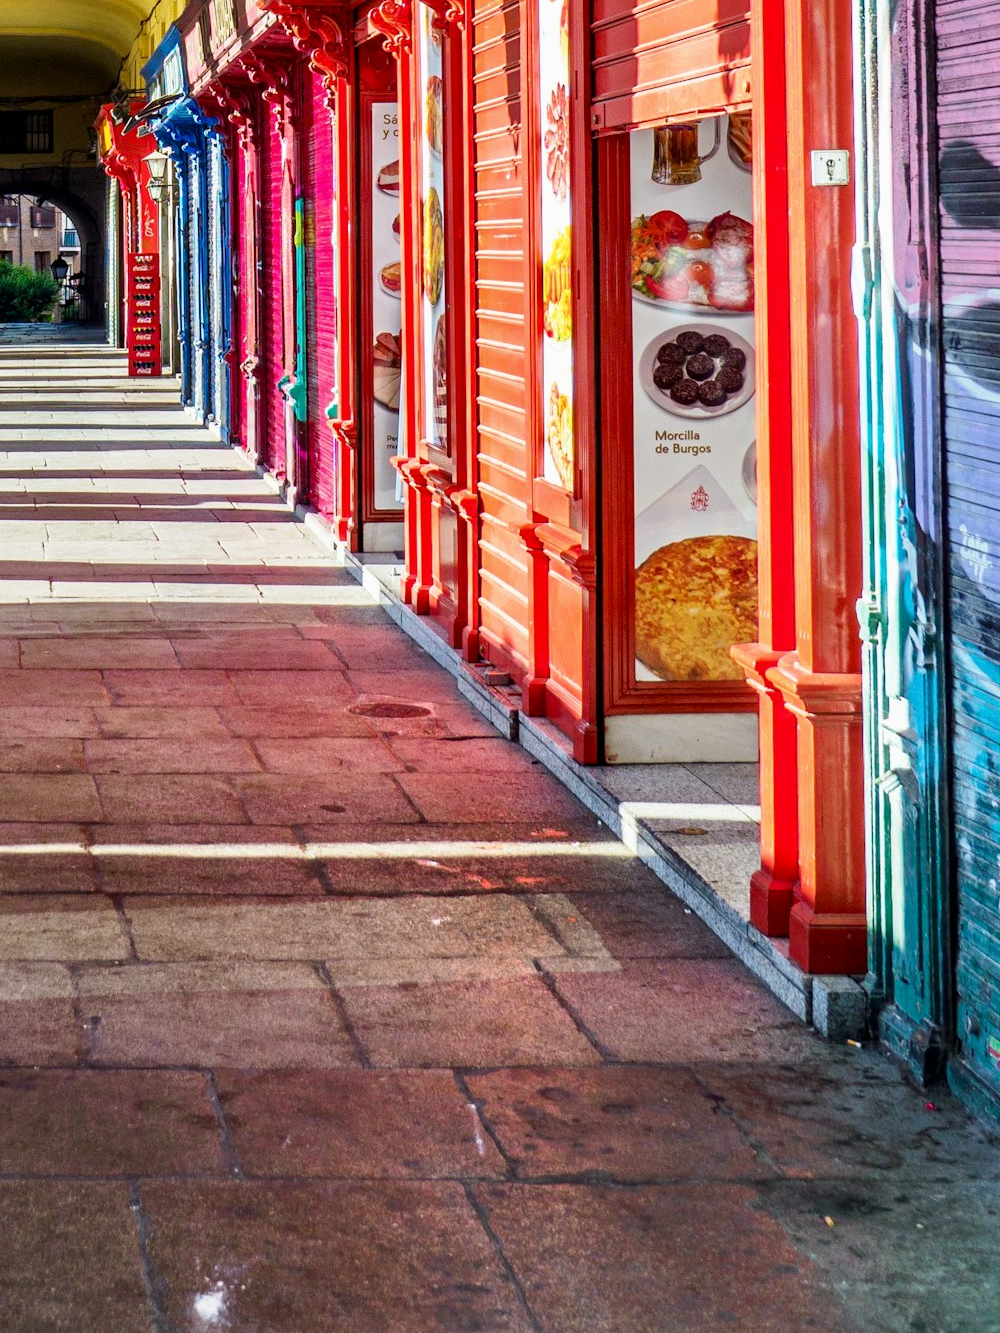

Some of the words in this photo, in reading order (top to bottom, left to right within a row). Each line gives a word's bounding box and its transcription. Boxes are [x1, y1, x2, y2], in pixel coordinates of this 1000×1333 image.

[382, 129, 390, 140] y
[655, 429, 700, 441] Morcilla
[655, 443, 669, 454] de
[673, 443, 711, 456] Burgos
